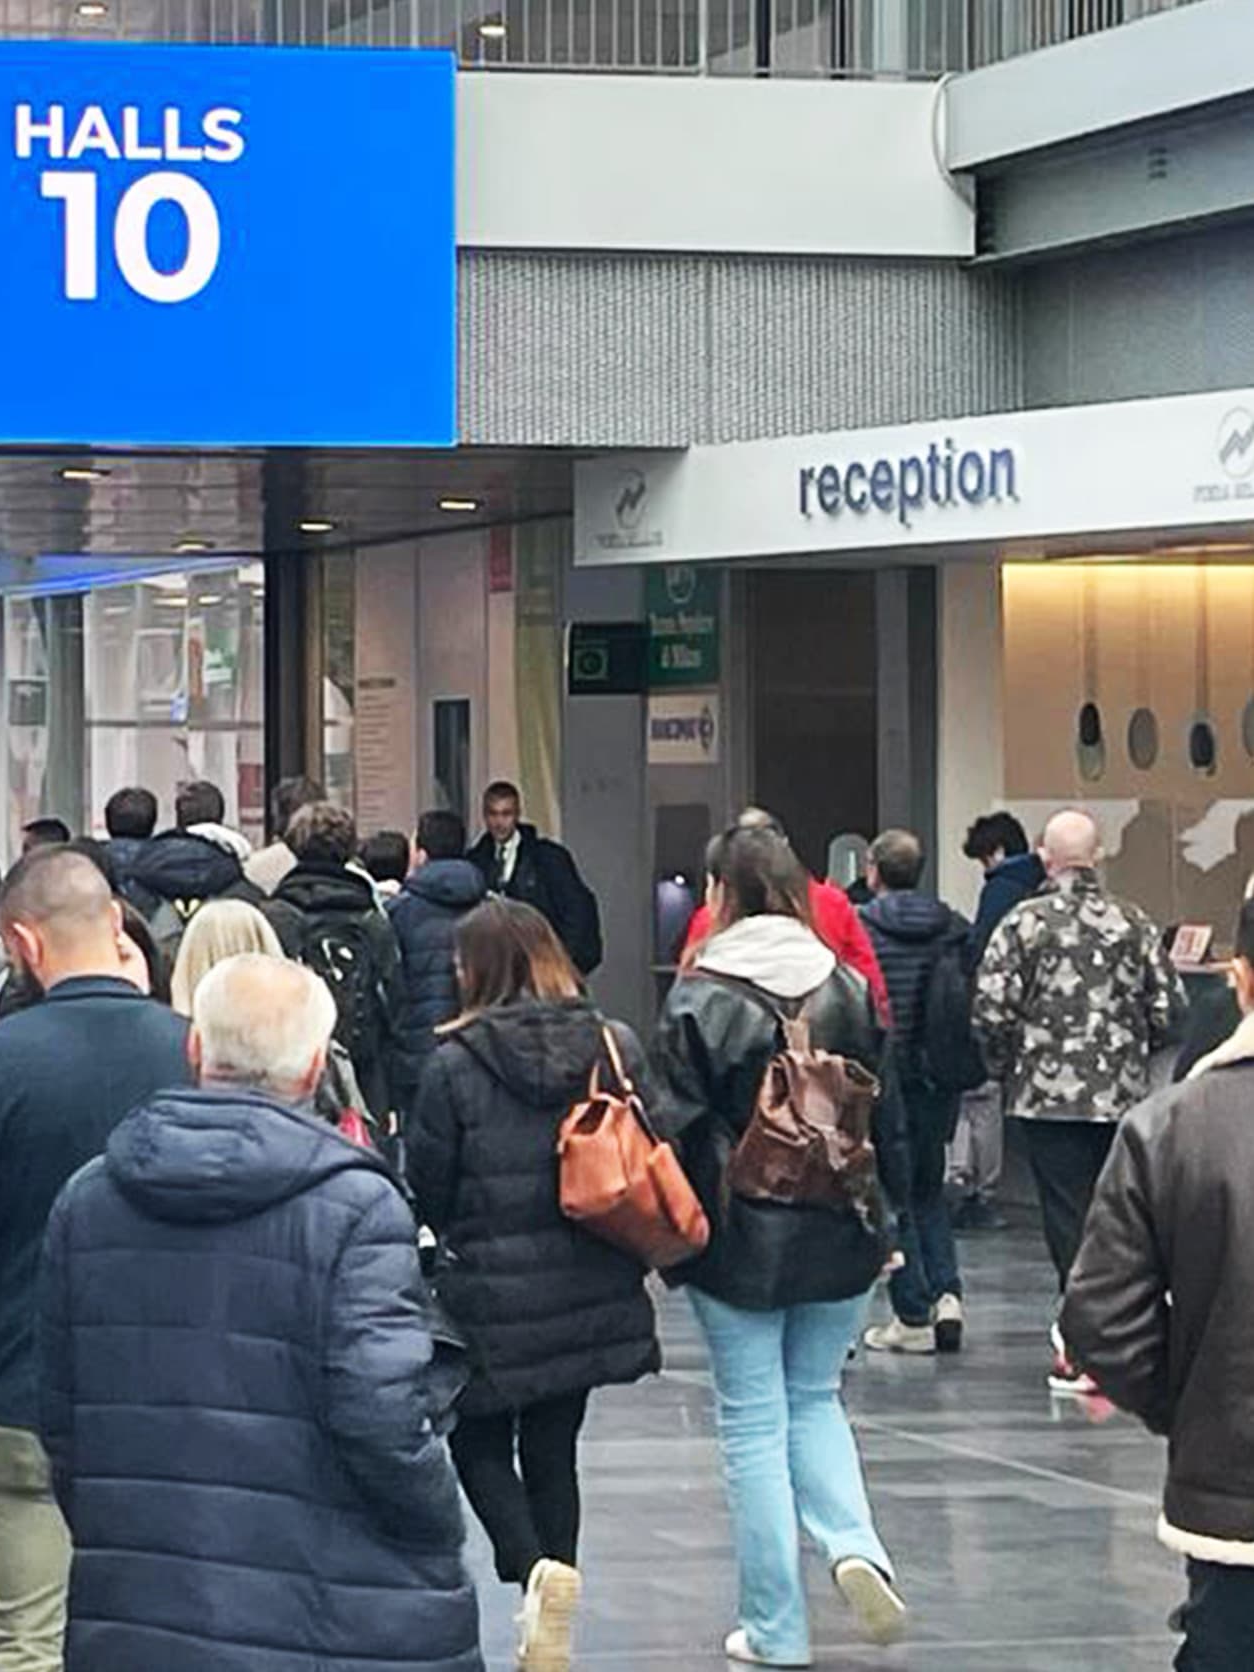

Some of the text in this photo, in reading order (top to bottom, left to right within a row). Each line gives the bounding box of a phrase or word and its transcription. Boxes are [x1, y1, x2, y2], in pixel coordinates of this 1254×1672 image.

[15, 103, 245, 163] HALLS
[40, 170, 222, 304] 10
[799, 437, 1018, 526] reception
